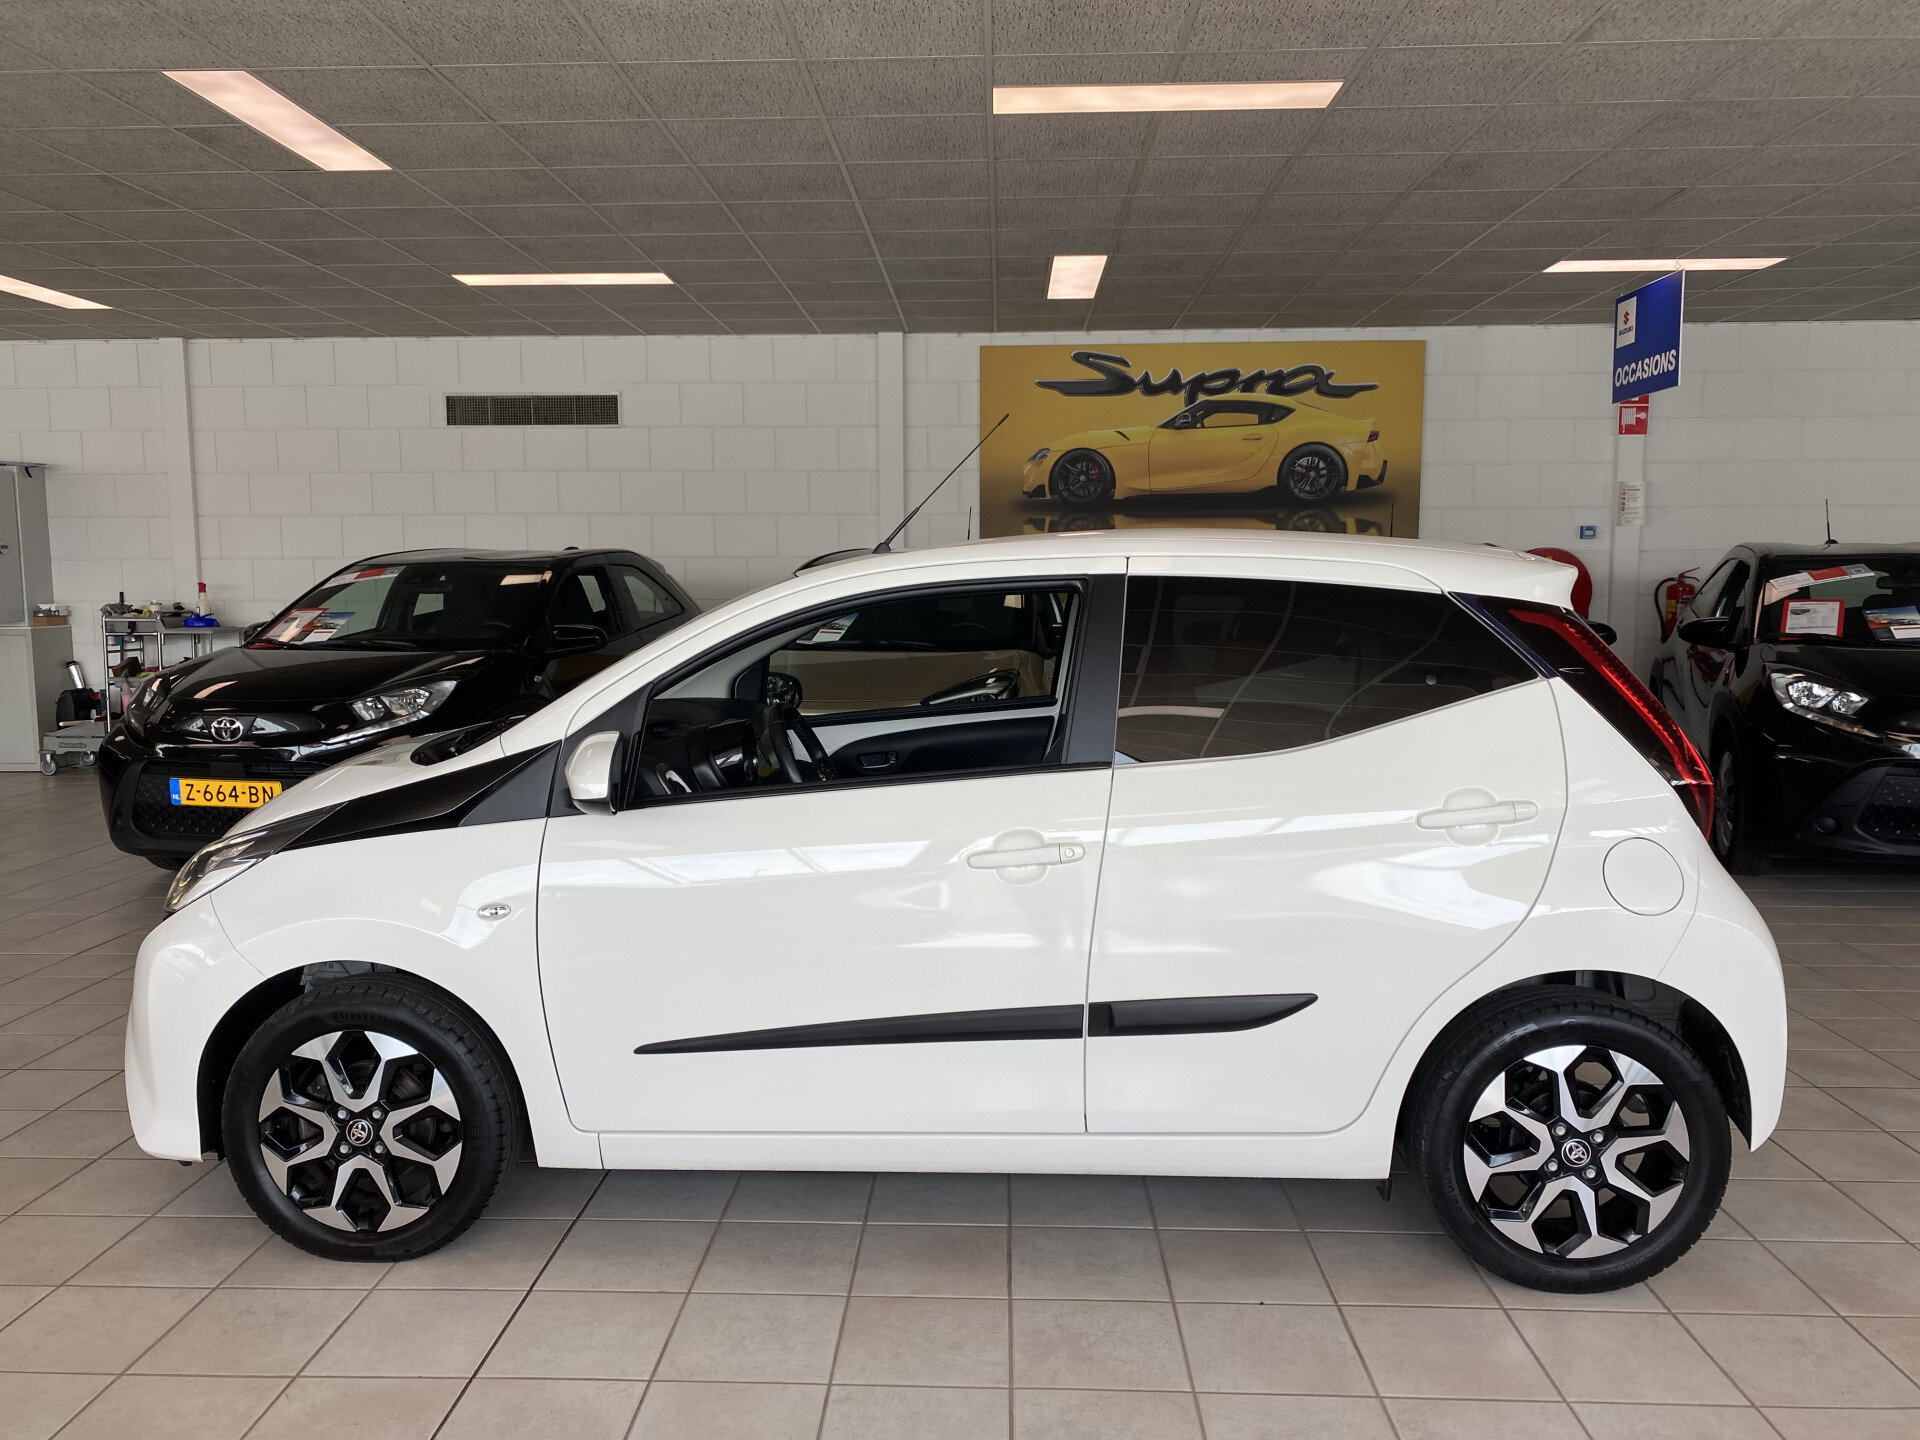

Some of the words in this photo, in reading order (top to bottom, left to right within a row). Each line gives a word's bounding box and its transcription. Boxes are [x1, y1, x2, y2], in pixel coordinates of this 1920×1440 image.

[1035, 350, 1380, 408] Supra
[1615, 349, 1676, 387] OCCASIONS
[185, 784, 274, 804] Z-664-BN
